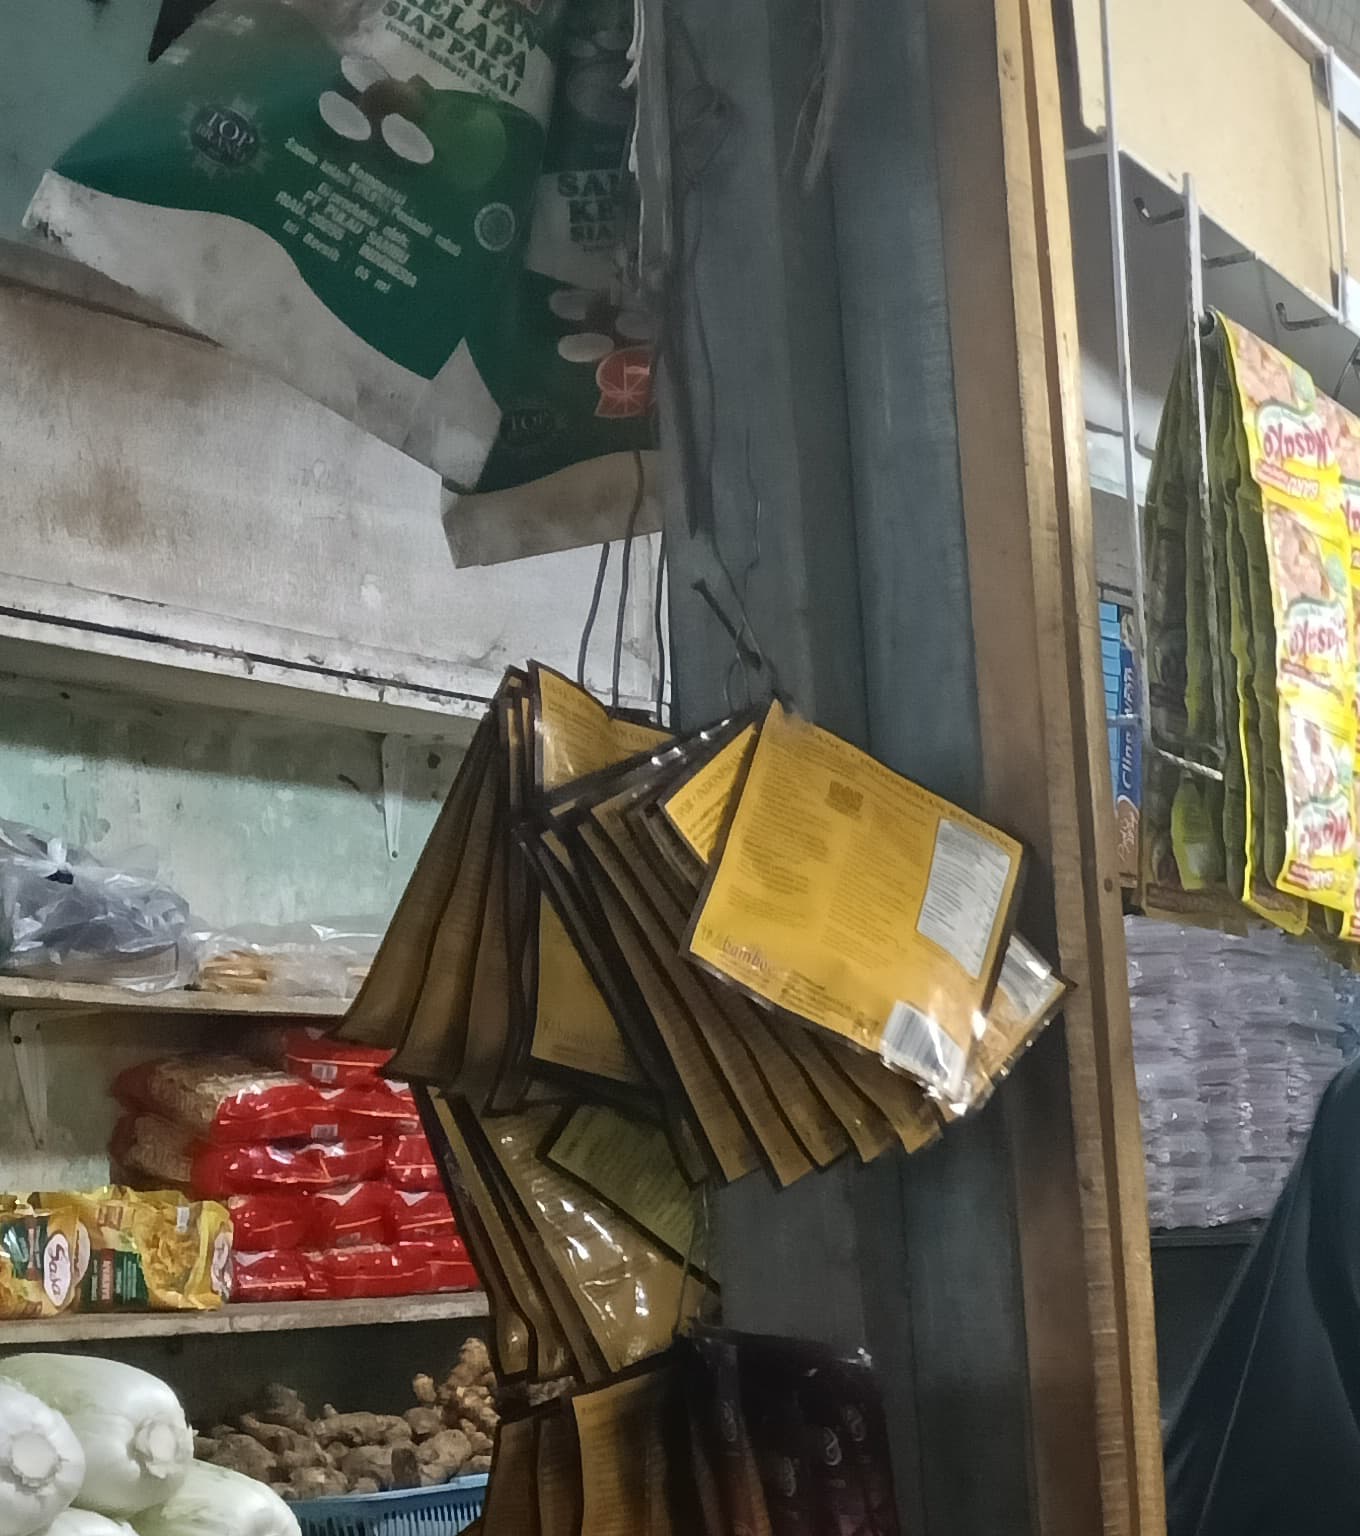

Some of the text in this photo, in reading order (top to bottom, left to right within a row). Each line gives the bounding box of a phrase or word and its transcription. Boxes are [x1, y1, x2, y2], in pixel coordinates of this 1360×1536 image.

[382, 0, 521, 97] SIAP PAKAI
[206, 111, 255, 147] TOP
[1263, 422, 1333, 470] Masako
